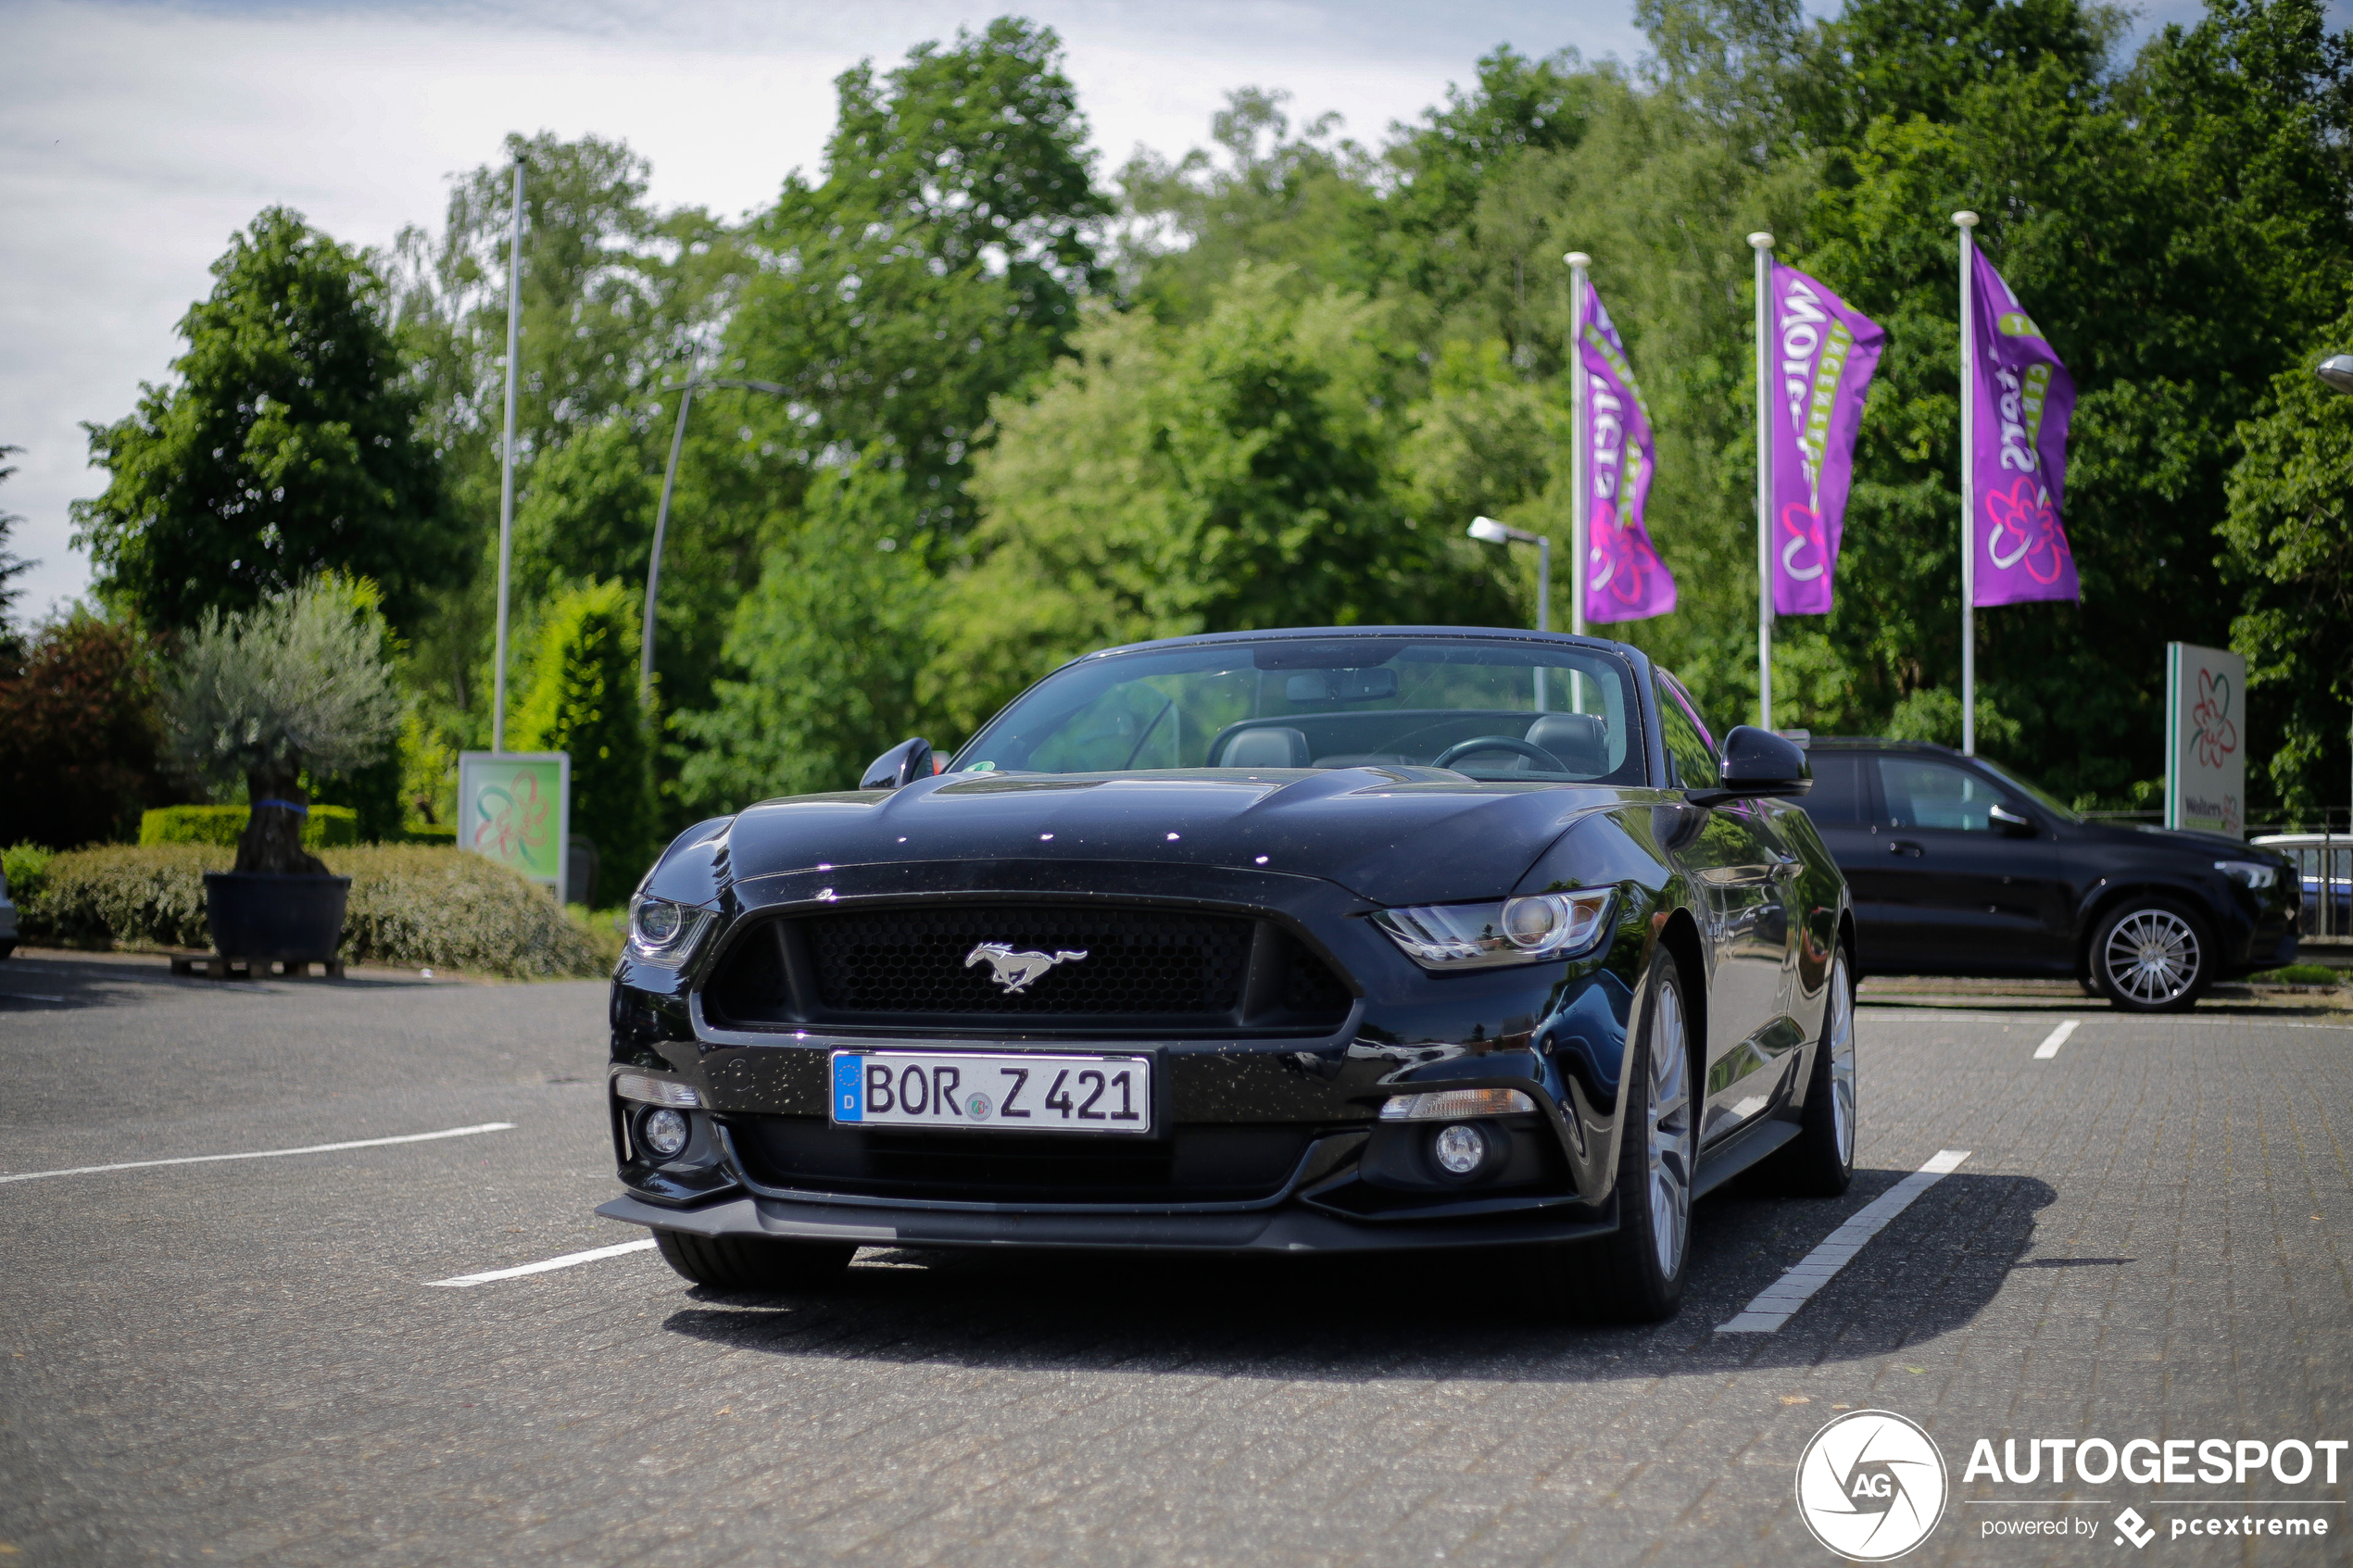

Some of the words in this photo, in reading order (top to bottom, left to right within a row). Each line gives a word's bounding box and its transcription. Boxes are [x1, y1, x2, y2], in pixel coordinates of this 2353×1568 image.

[844, 1095, 855, 1110] D
[866, 1064, 963, 1116] BOR
[1000, 1067, 1031, 1118] Z
[1045, 1069, 1140, 1121] 421
